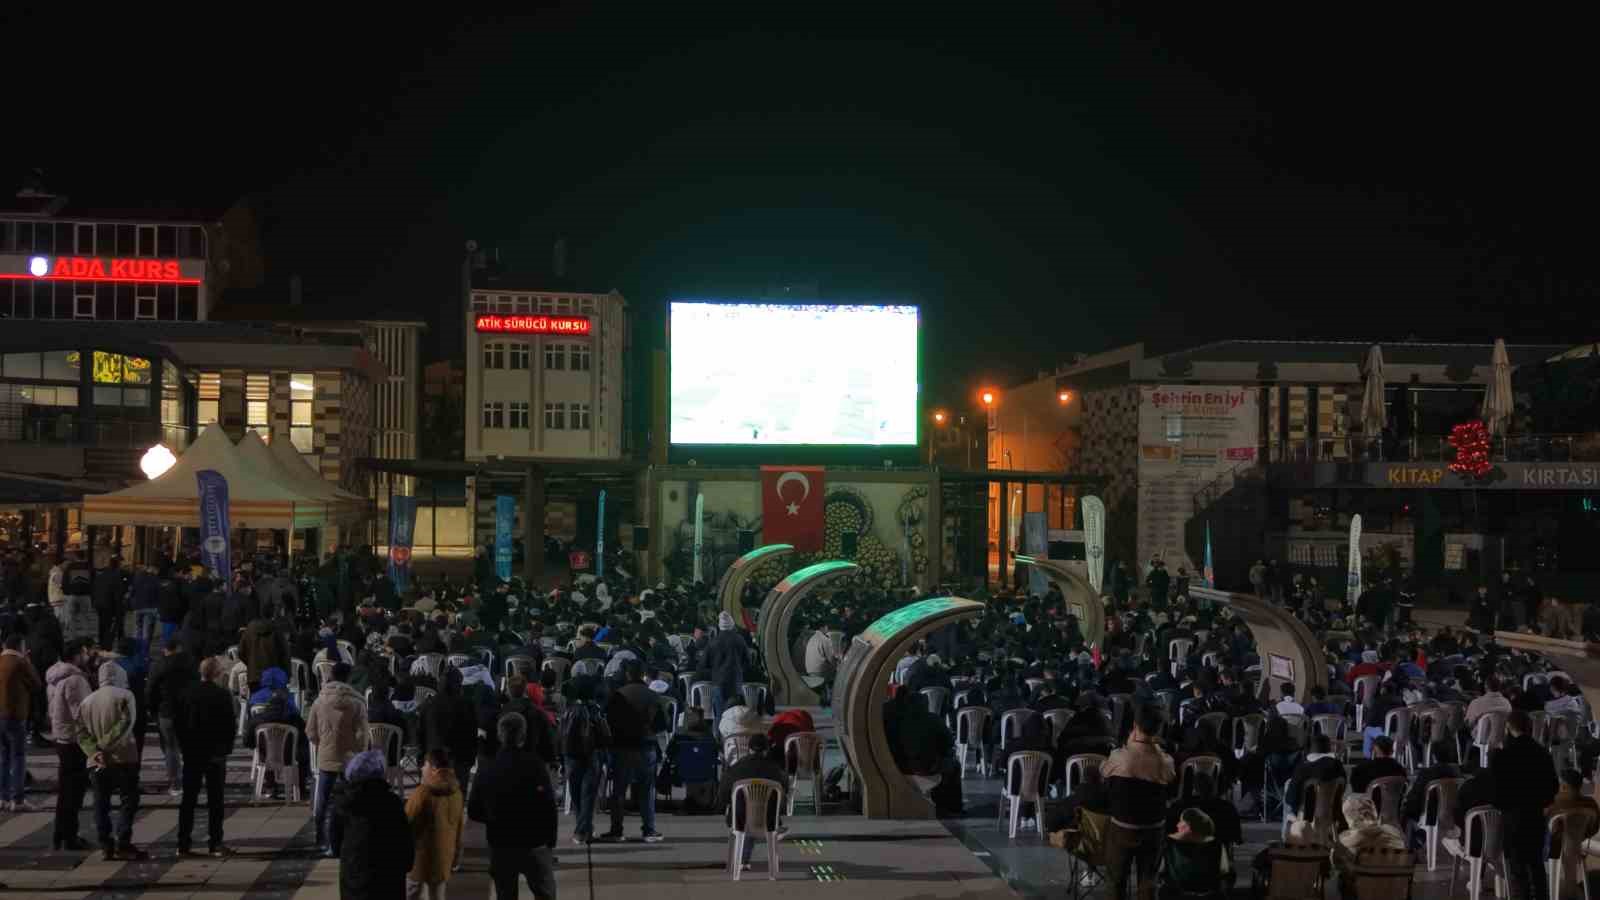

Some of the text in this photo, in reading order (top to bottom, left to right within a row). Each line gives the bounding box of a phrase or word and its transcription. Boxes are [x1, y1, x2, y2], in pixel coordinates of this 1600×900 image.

[54, 257, 181, 279] ADA KURS
[477, 316, 588, 331] ATİK SÜRÜCÜ KURSU
[1205, 393, 1222, 405] En
[1387, 465, 1442, 484] KİTAP
